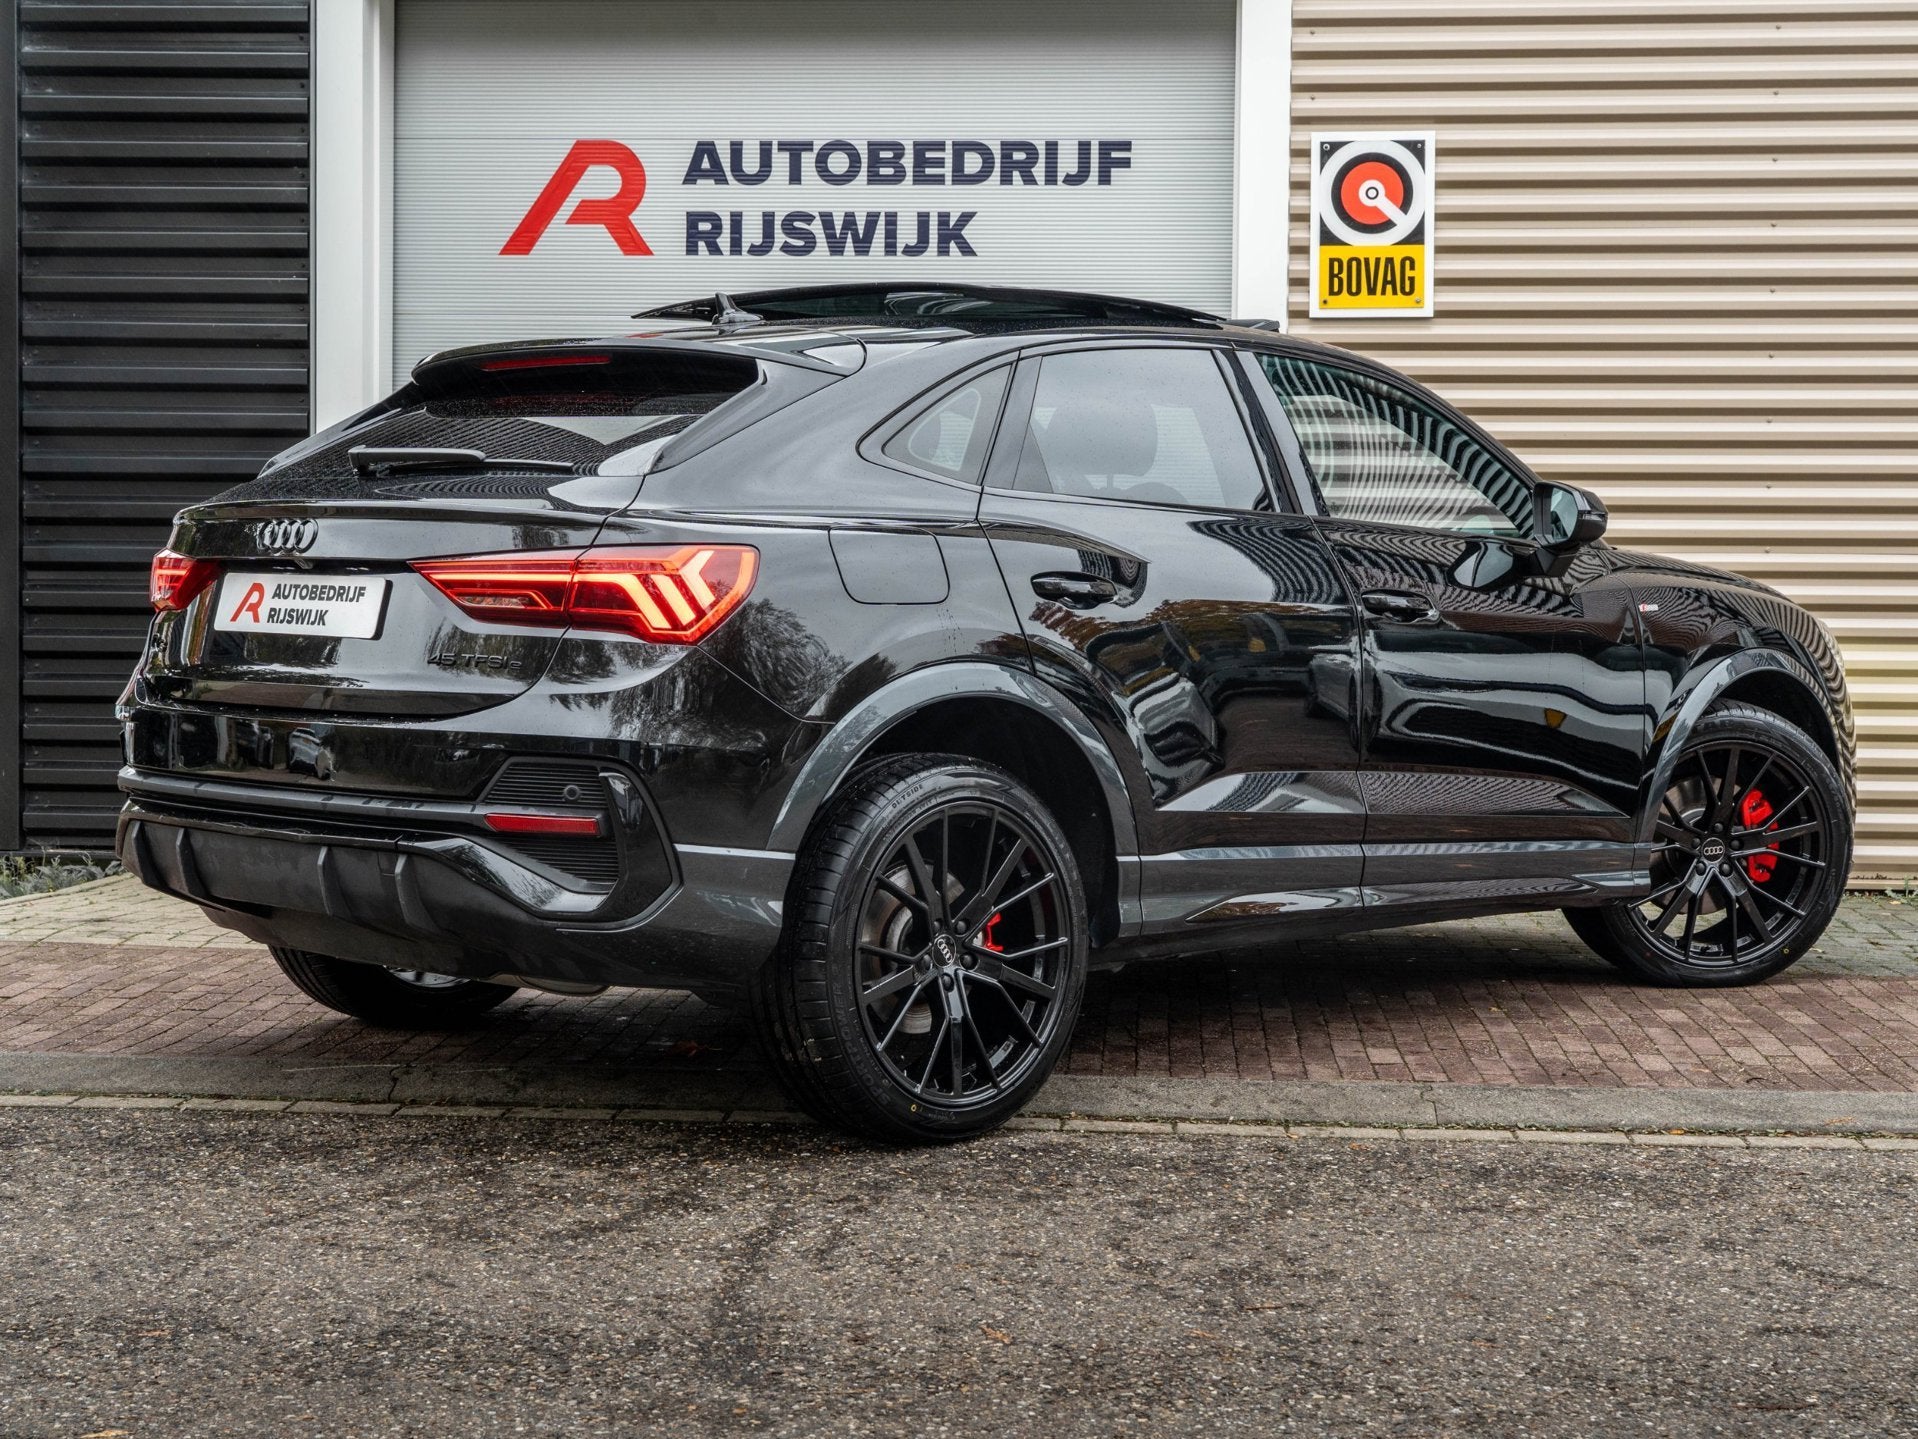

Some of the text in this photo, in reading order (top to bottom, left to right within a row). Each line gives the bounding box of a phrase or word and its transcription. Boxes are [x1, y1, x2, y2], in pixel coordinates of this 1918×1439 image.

[682, 140, 1132, 186] AUTOBEDRIJF
[685, 211, 978, 257] RIJSWIJK
[1328, 256, 1416, 297] BOVAG
[271, 583, 367, 603] AUTOBEDRIJF
[266, 607, 329, 626] RIJSWIJK
[427, 653, 457, 666] 45
